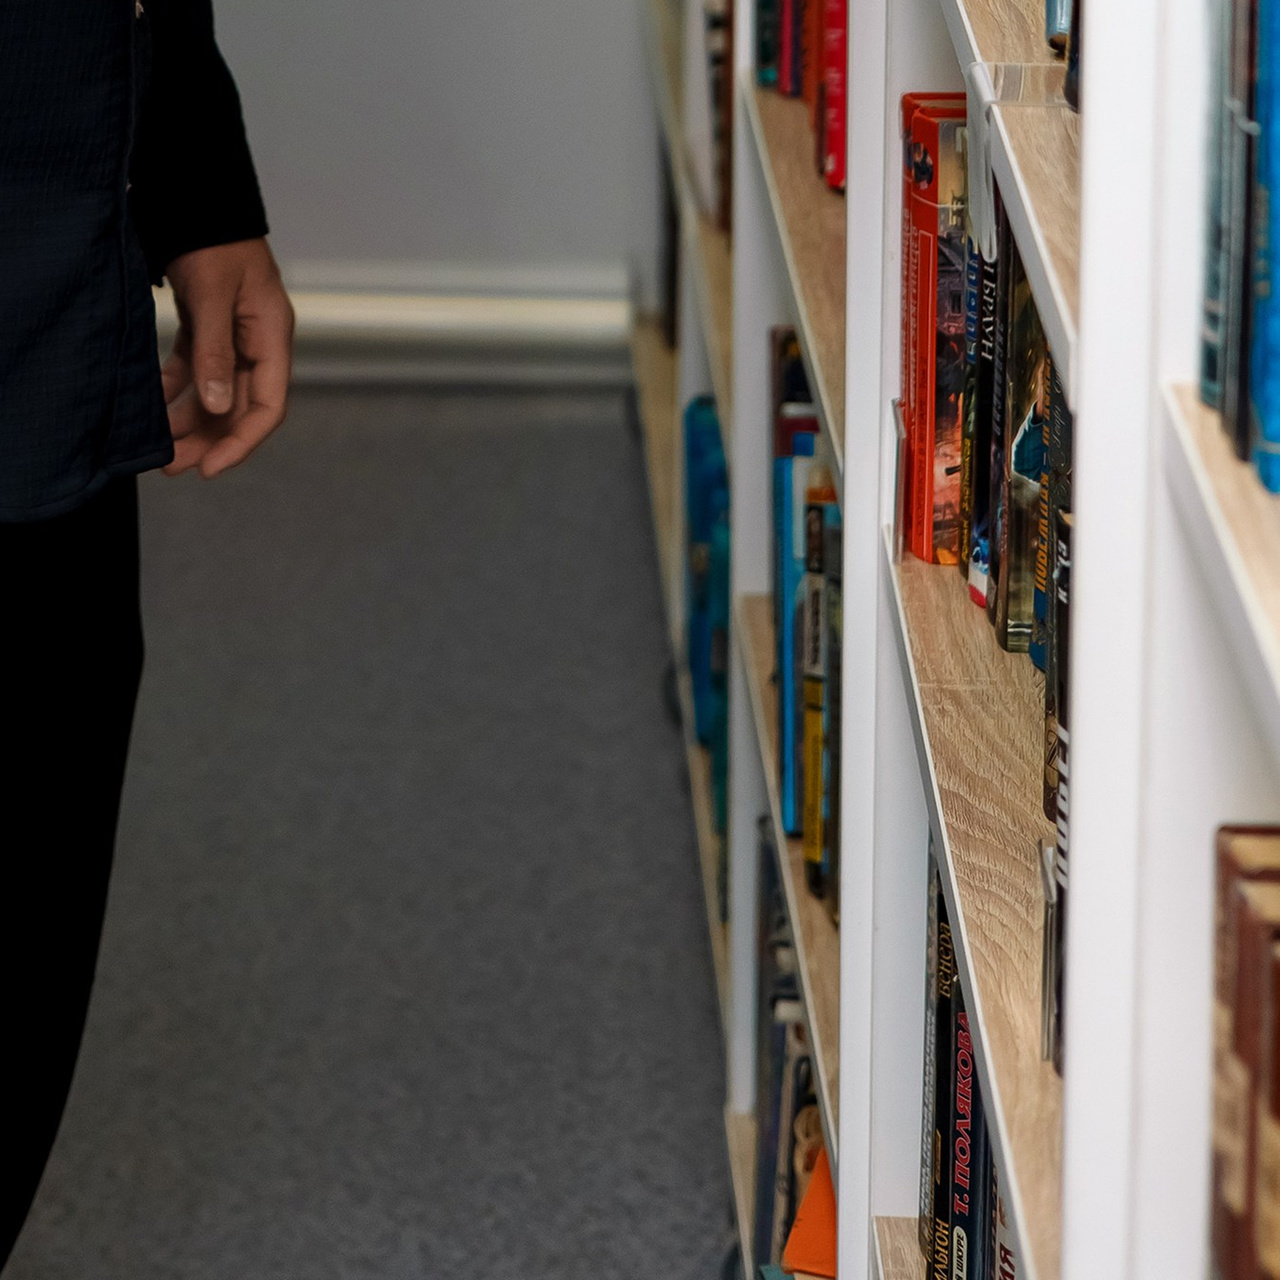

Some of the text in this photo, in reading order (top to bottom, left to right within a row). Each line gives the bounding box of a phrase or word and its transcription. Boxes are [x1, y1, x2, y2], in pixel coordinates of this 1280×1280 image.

[980, 279, 996, 360] БРАУН
[954, 1011, 973, 1217] Т. ПОЛЯКОВА
[956, 1232, 964, 1272] ШКУРЕ
